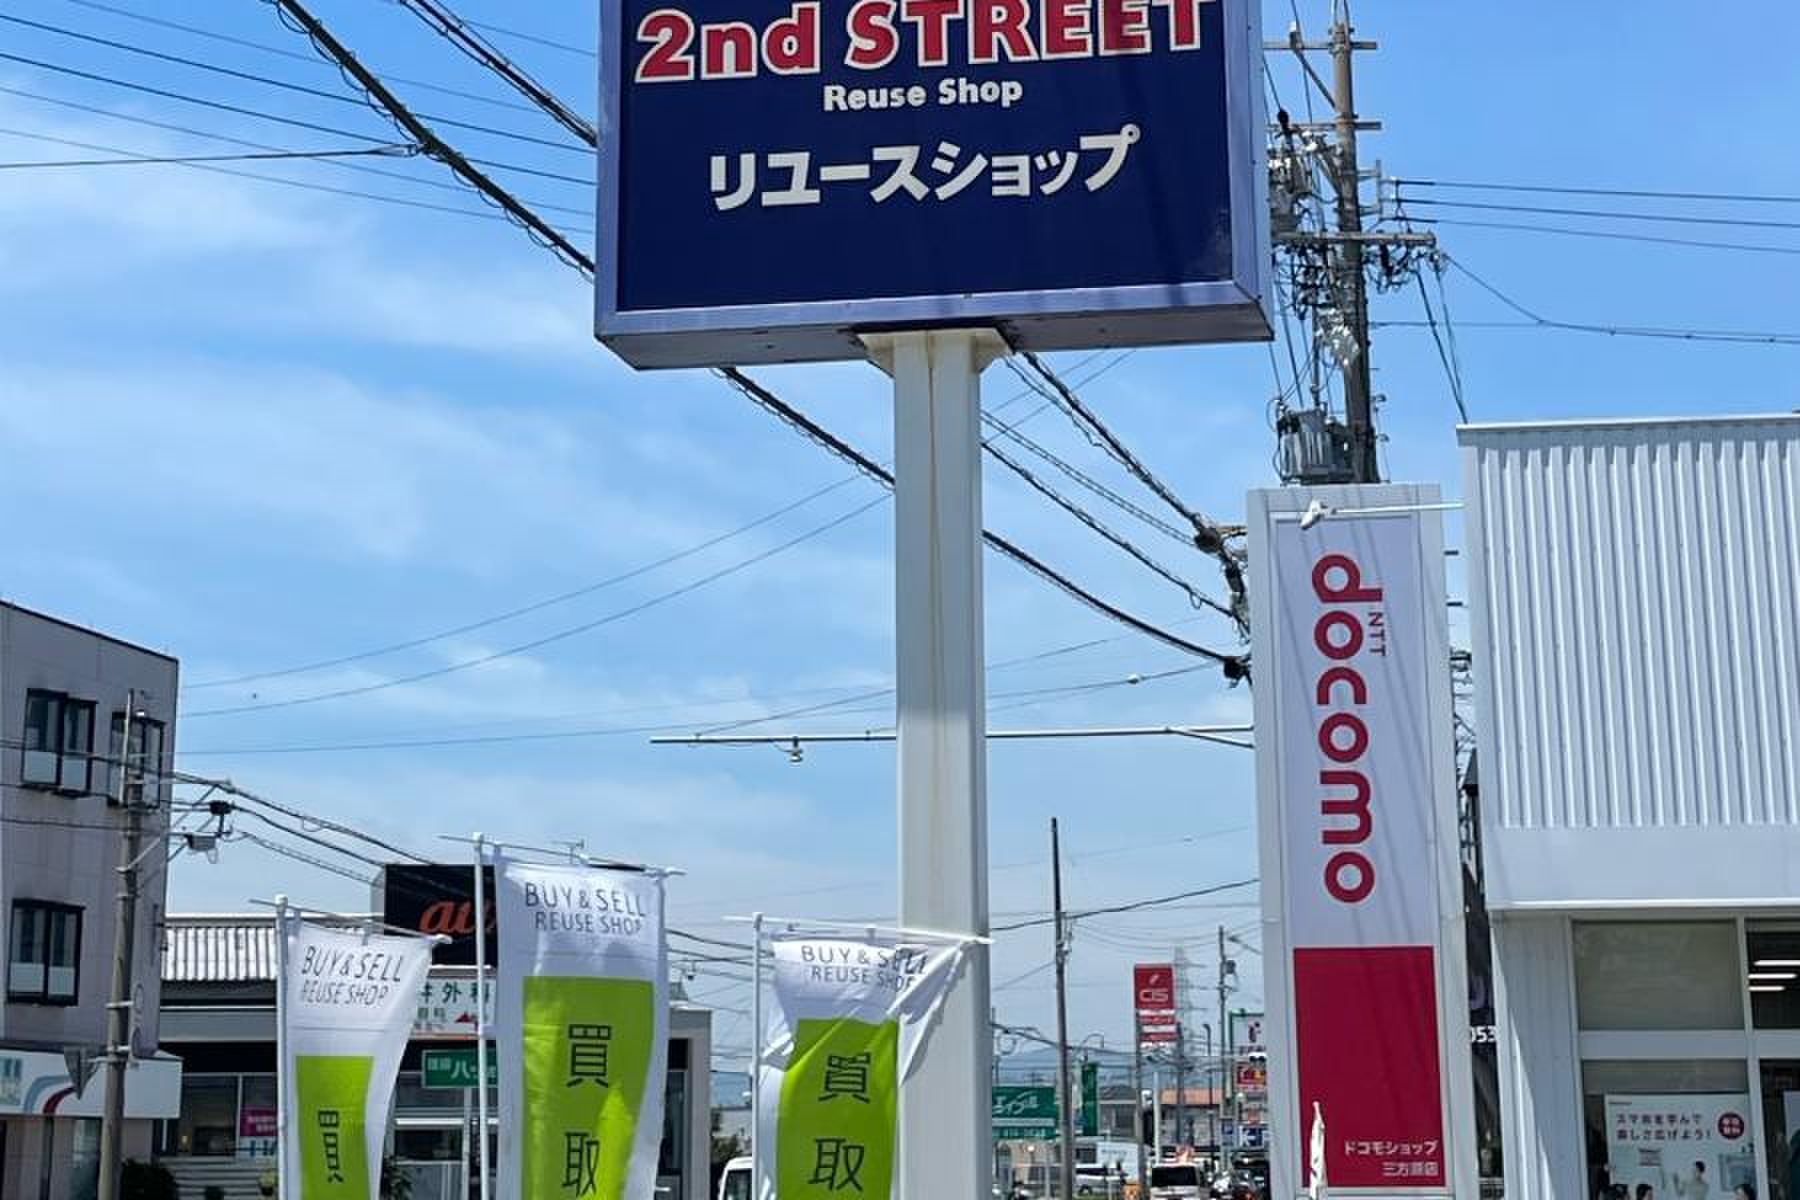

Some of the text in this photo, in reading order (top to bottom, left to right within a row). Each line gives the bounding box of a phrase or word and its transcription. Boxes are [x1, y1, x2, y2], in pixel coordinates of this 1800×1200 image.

[634, 0, 822, 84] 2nd
[823, 77, 1023, 112] Reuse Shop
[709, 123, 1142, 212] リユースショップ
[1367, 611, 1387, 658] NTT
[1311, 554, 1384, 904] docomo
[525, 882, 572, 909] BUY
[595, 888, 646, 918] SELL
[535, 911, 641, 936] REUSE SHOP
[811, 965, 868, 984] REUSE
[561, 1024, 612, 1197] 買取
[1344, 1140, 1440, 1157] ドコモショップ
